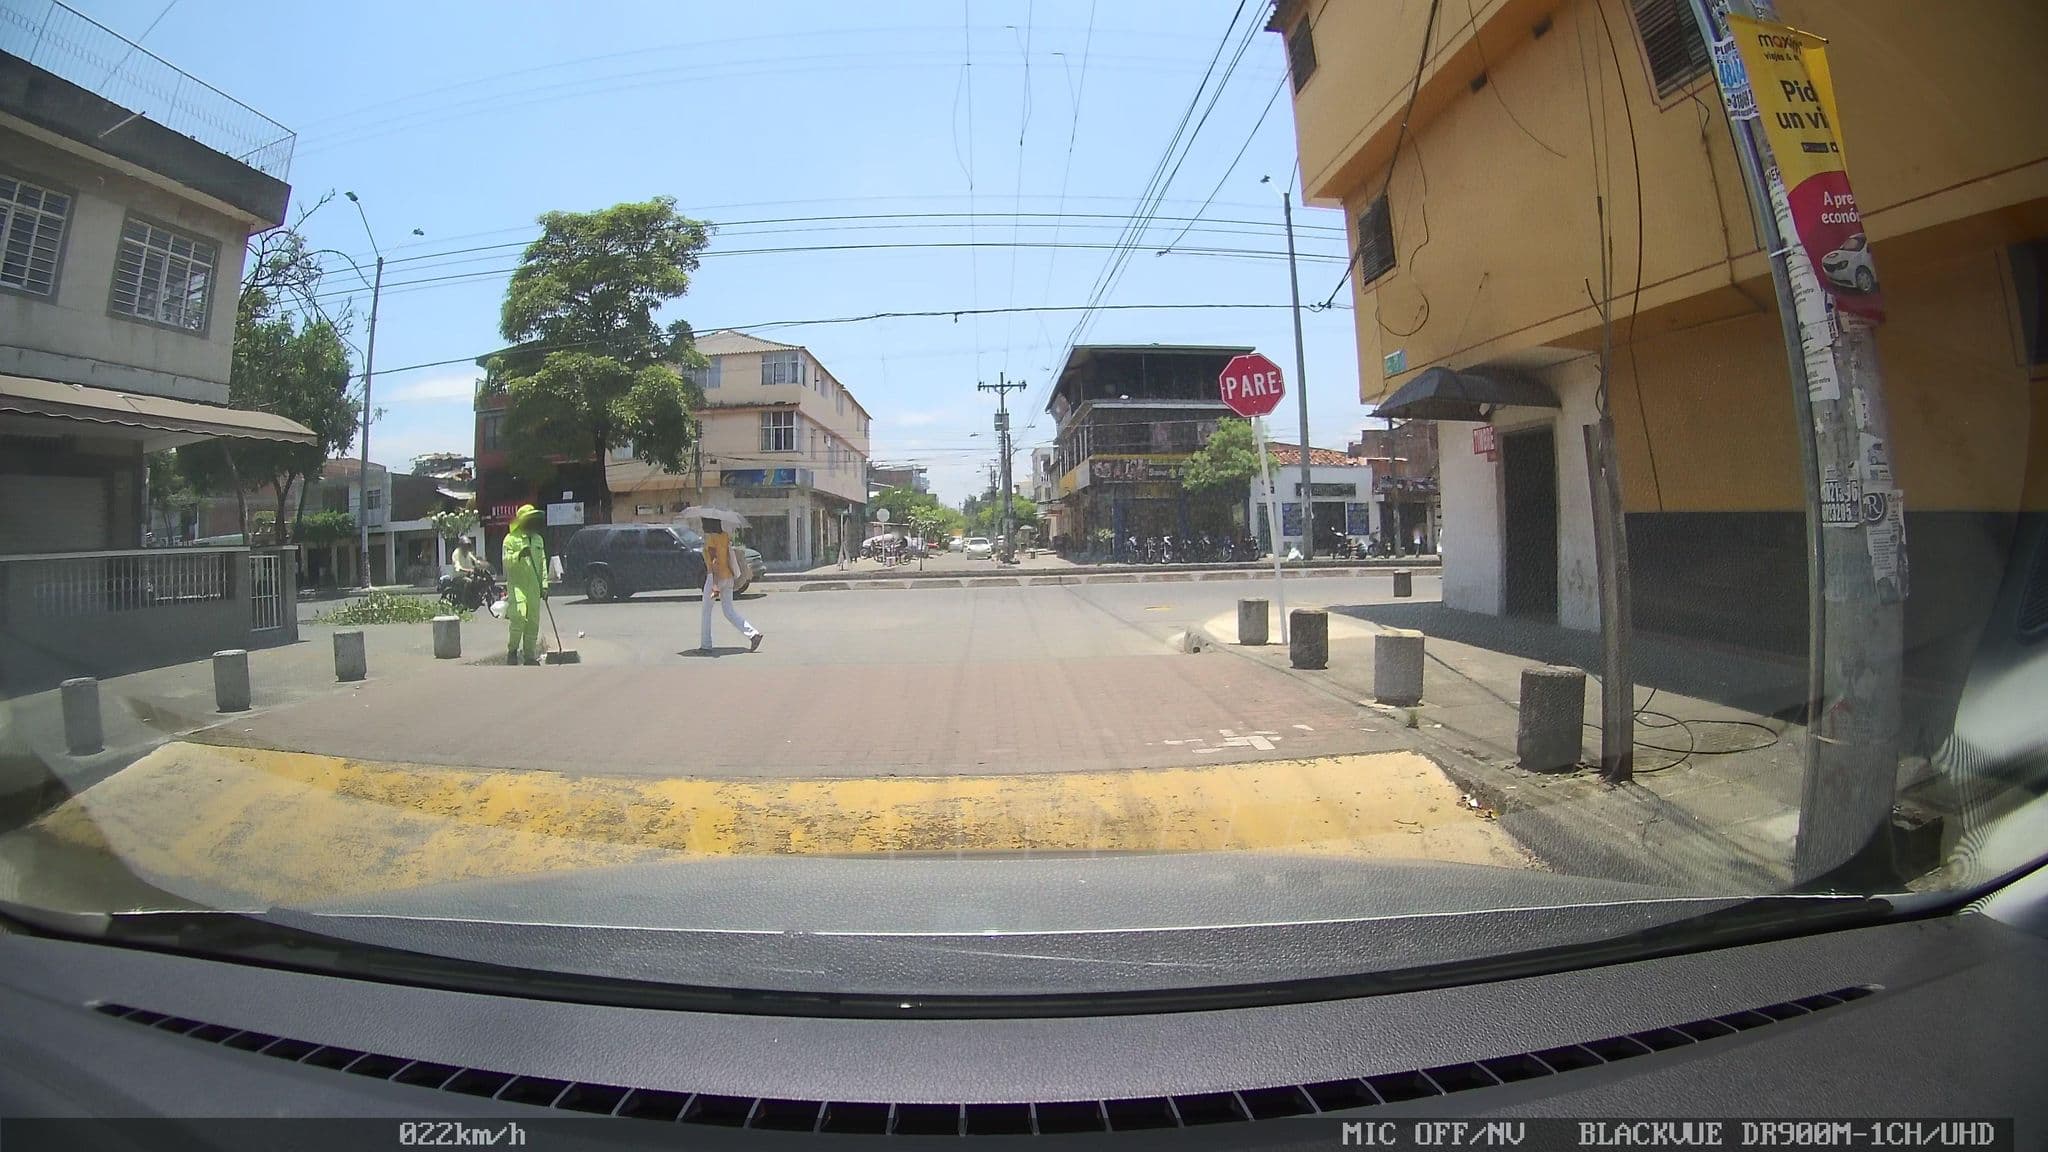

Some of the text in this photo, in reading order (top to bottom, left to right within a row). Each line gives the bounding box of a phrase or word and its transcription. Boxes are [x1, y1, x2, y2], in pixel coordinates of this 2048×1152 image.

[1776, 112, 1805, 129] un
[1823, 191, 1833, 206] A
[1226, 371, 1279, 399] PARE
